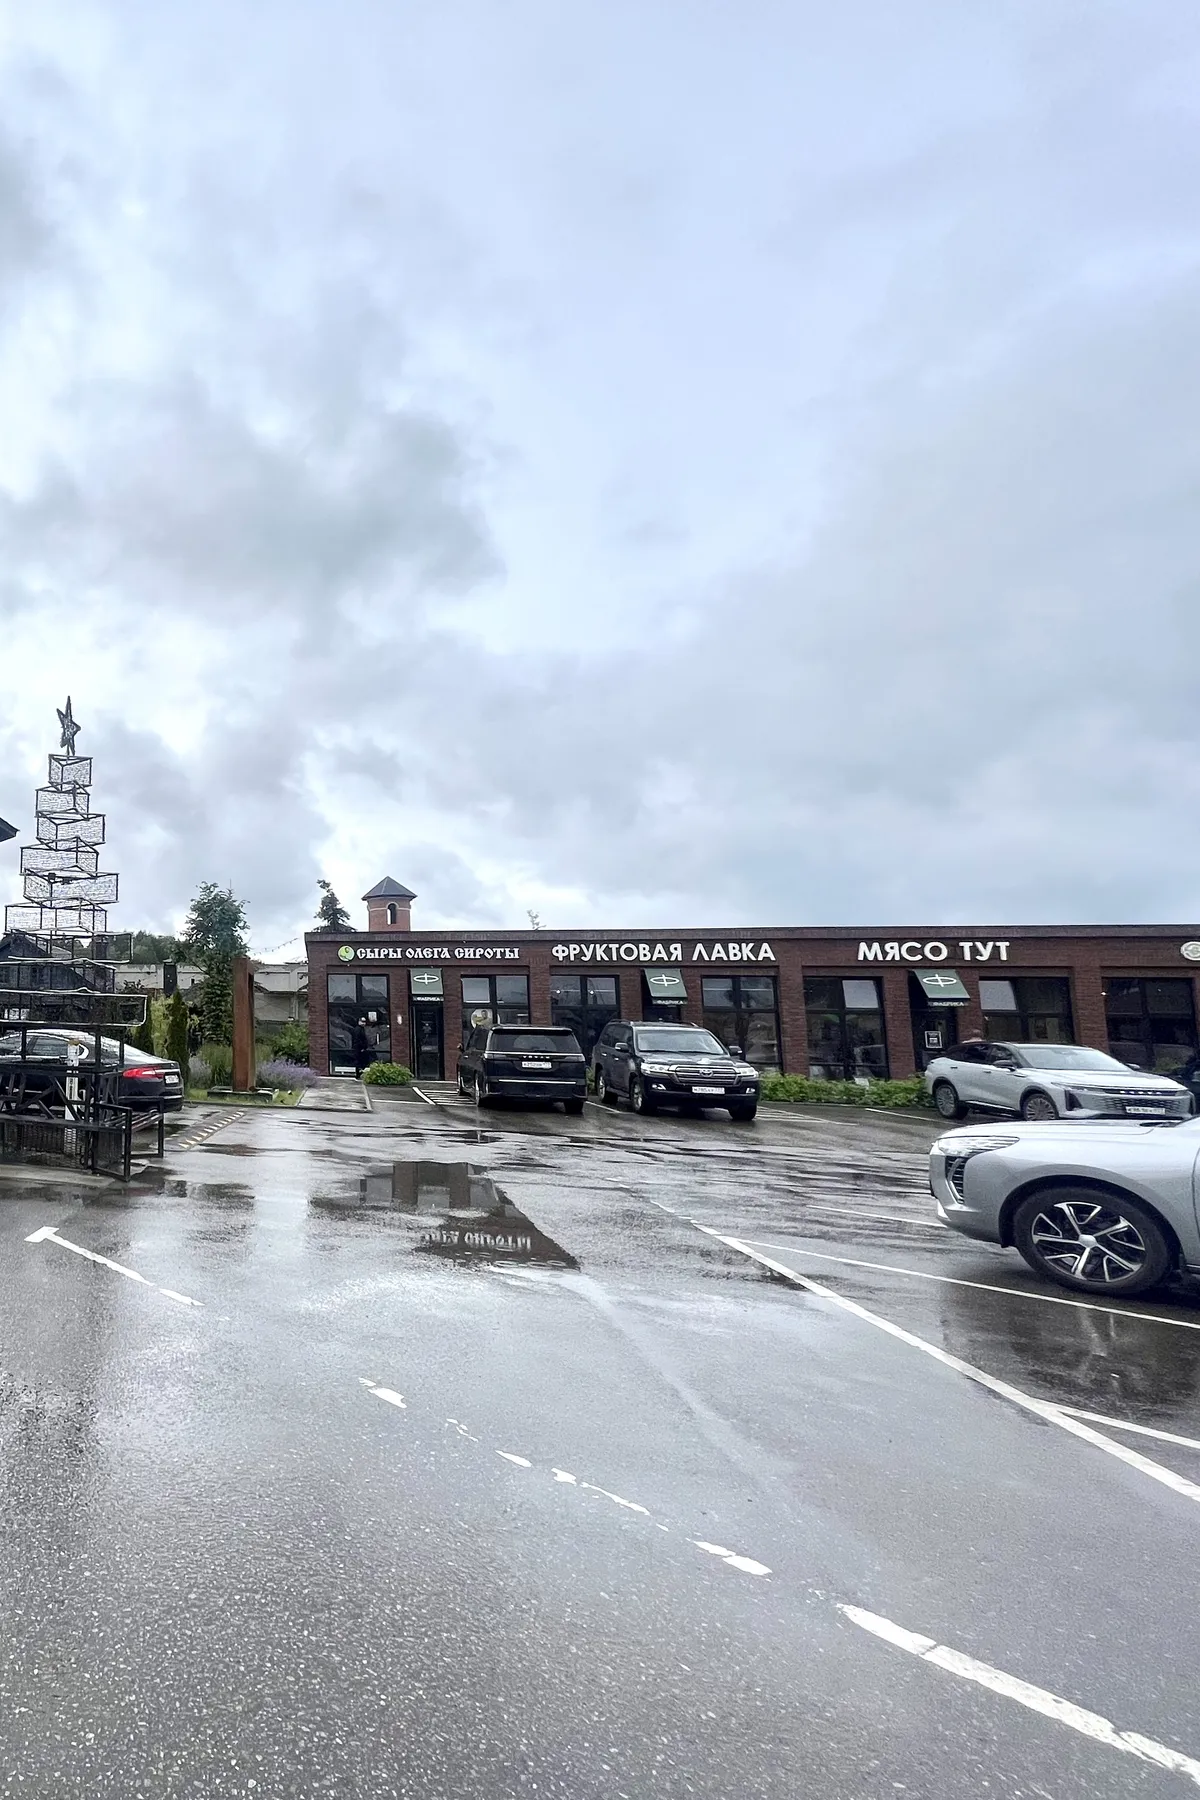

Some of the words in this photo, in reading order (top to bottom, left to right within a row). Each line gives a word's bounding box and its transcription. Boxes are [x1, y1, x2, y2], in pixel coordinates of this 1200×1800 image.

[357, 948, 402, 959] СЫРЫ
[406, 948, 451, 959] ОЛЕГА
[455, 948, 520, 959] СИРОТЫ
[552, 944, 682, 961] ФРУКТОВАЯ
[692, 943, 776, 961] ЛАВКА
[857, 942, 948, 961] МЯСО
[959, 942, 1010, 961] ТУТ
